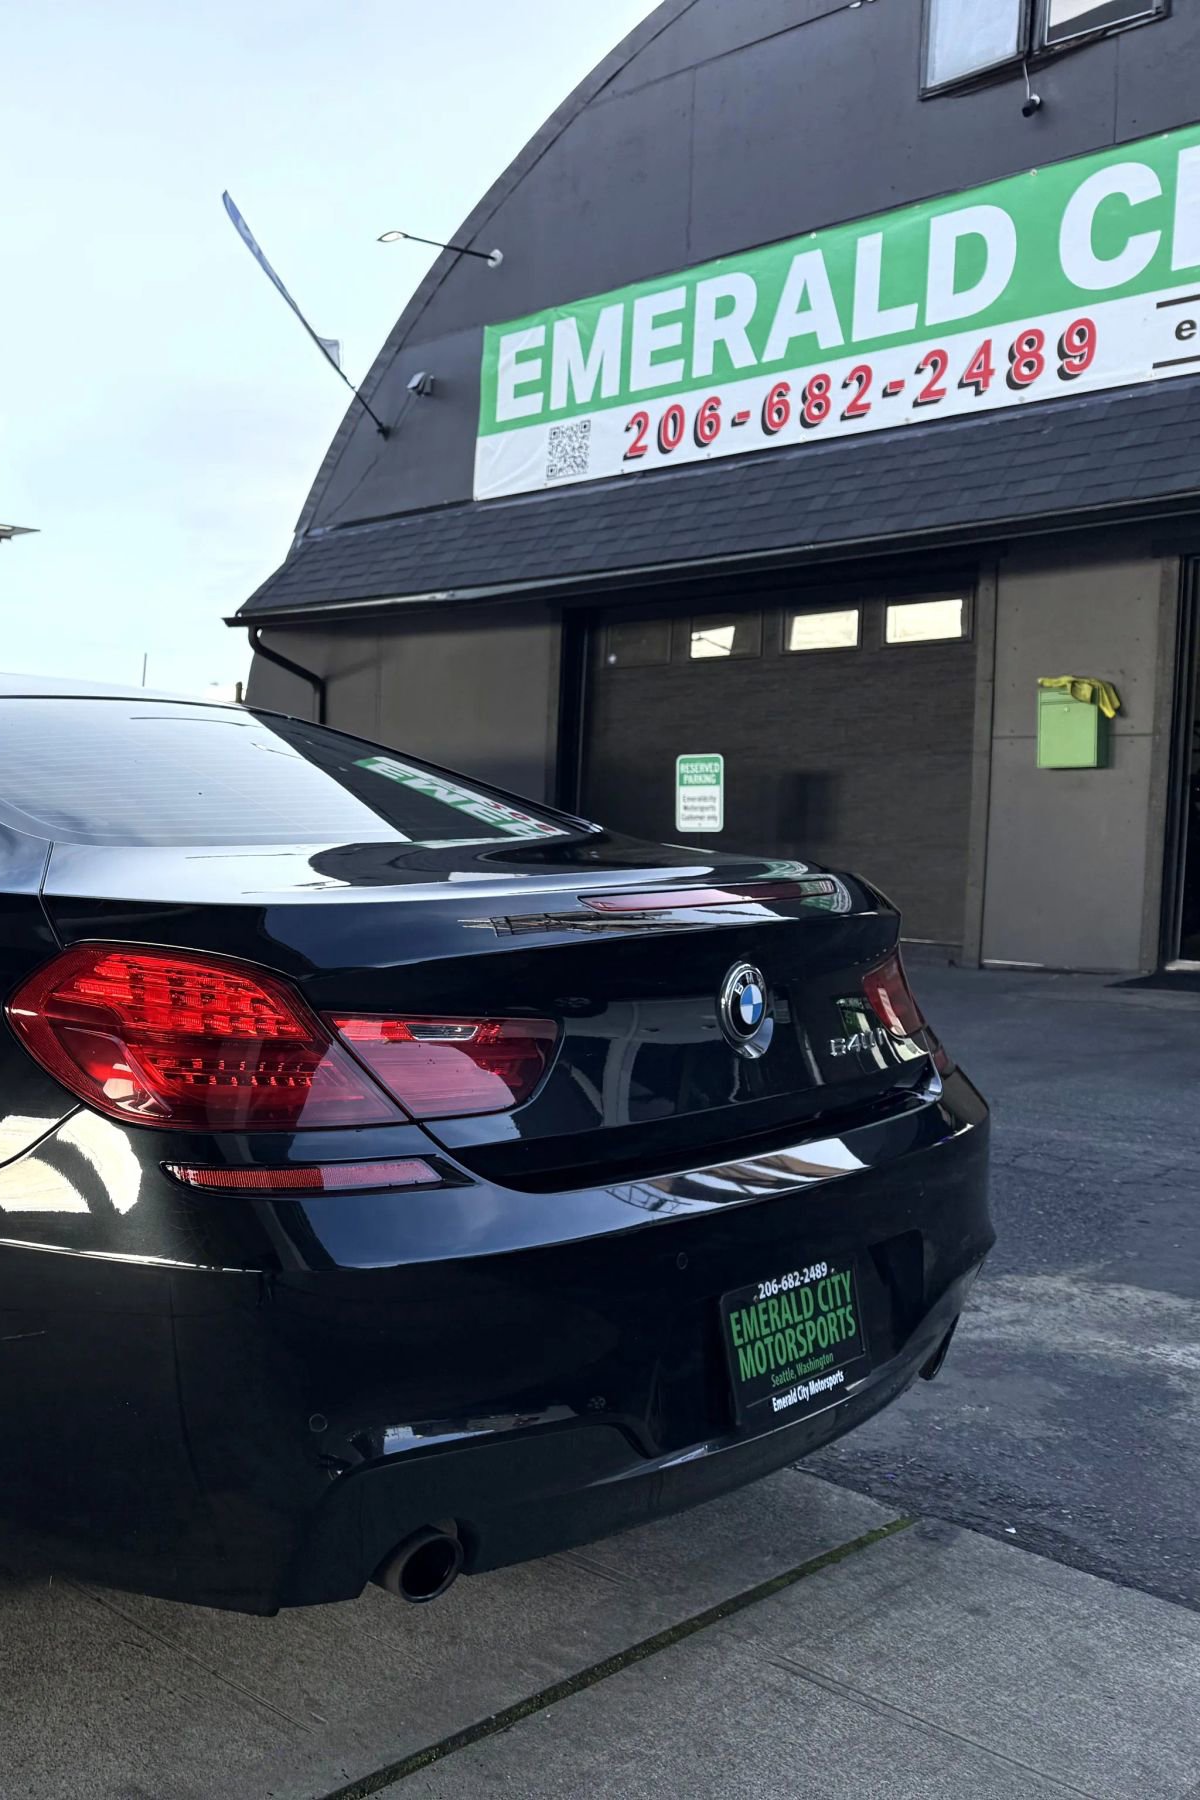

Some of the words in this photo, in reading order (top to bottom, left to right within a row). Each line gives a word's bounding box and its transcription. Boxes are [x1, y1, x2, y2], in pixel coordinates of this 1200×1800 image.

[495, 204, 1018, 423] EMERALD
[623, 317, 1097, 461] 206-682-2489
[729, 1286, 815, 1346] EMERALD
[817, 1270, 851, 1312] CITY
[758, 1261, 828, 1299] 206-682-2489
[738, 1304, 856, 1382] MOTORSPORTS
[770, 1367, 797, 1388] Seattle,
[796, 1352, 834, 1376] Washington
[772, 1387, 798, 1413] Emerald
[797, 1384, 809, 1401] City
[808, 1369, 844, 1396] Motorsports
